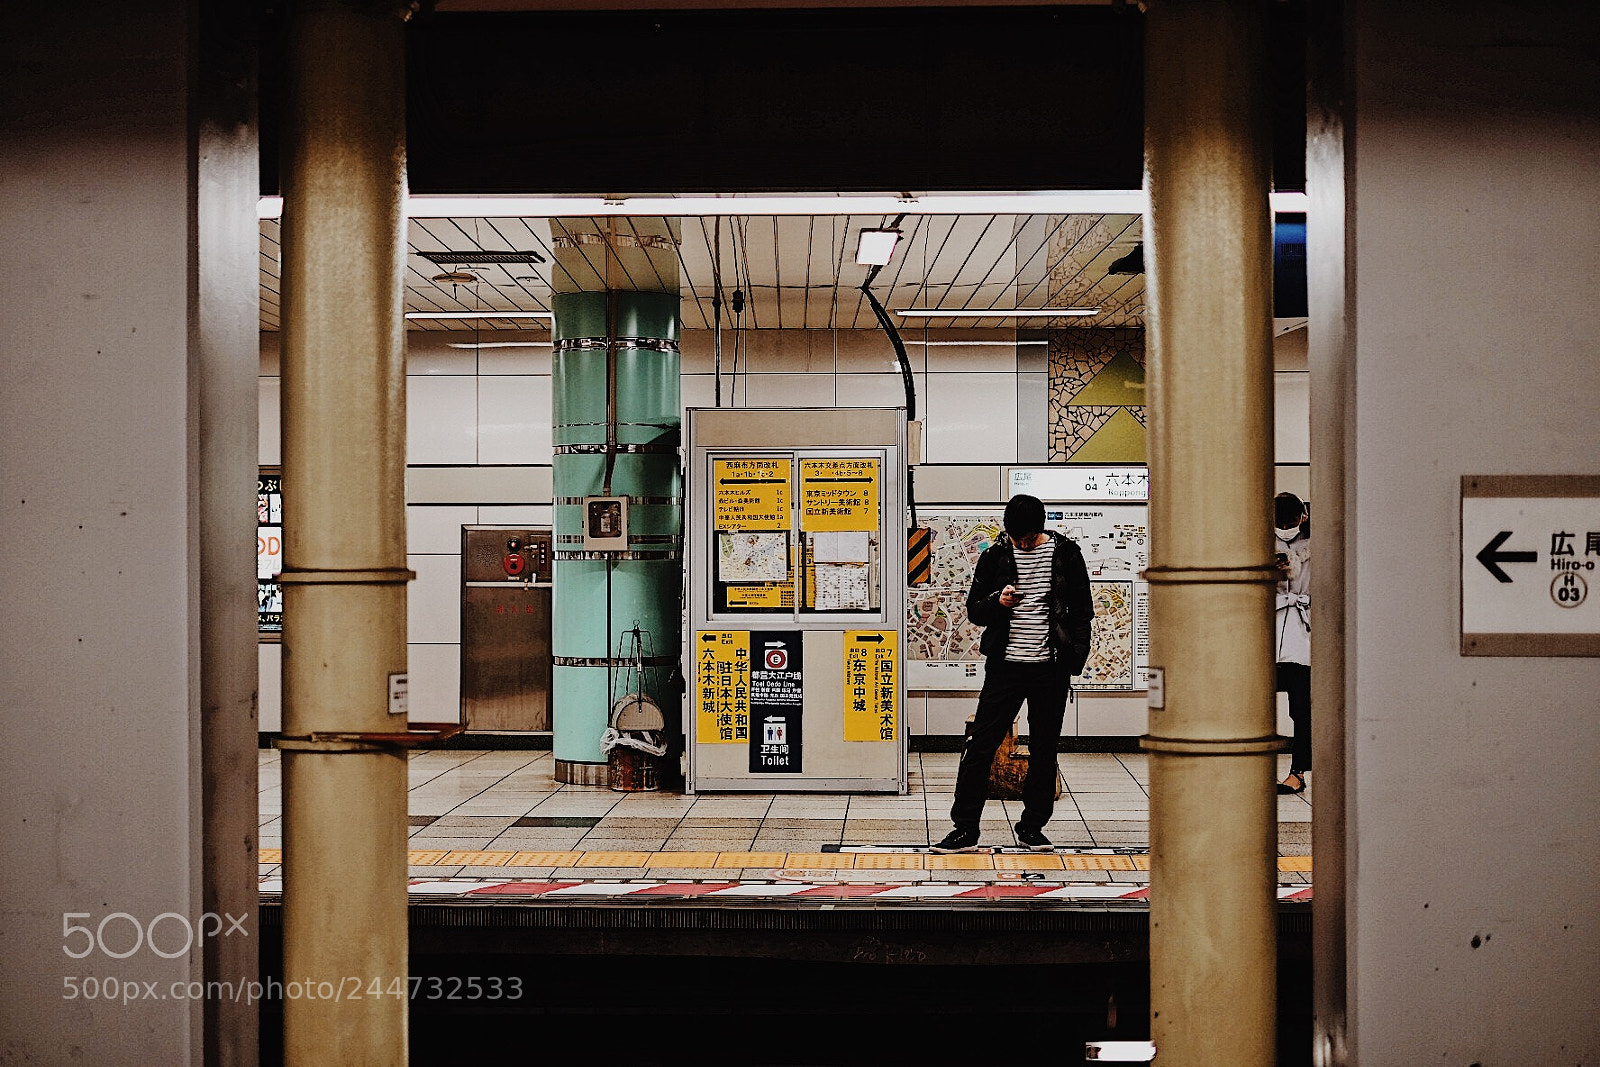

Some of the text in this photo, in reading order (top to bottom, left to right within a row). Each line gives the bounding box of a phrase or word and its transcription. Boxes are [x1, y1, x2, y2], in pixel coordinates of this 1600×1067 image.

[726, 461, 778, 469] 西麻布方面改札
[804, 461, 873, 469] 六本木交差点方面改札
[1106, 472, 1148, 486] 六本木
[806, 490, 856, 498] 東京ミッドタウン
[1108, 489, 1146, 498] Roppong
[806, 508, 852, 516] 国立新美術館
[1550, 531, 1600, 556] 広尾
[1550, 558, 1595, 570] Hiro-o
[1564, 576, 1574, 586] H
[1558, 588, 1580, 601] 03
[861, 648, 867, 657] 8
[887, 649, 892, 657] 7
[702, 648, 716, 713] 六本木新城
[853, 659, 866, 712] 东京中城
[734, 648, 748, 740] 中华人民共和国
[720, 660, 733, 740] 驻日本大使馆
[880, 660, 893, 740] 国立新美术馆
[760, 744, 789, 754] 卫生间
[760, 756, 789, 766] Toilet
